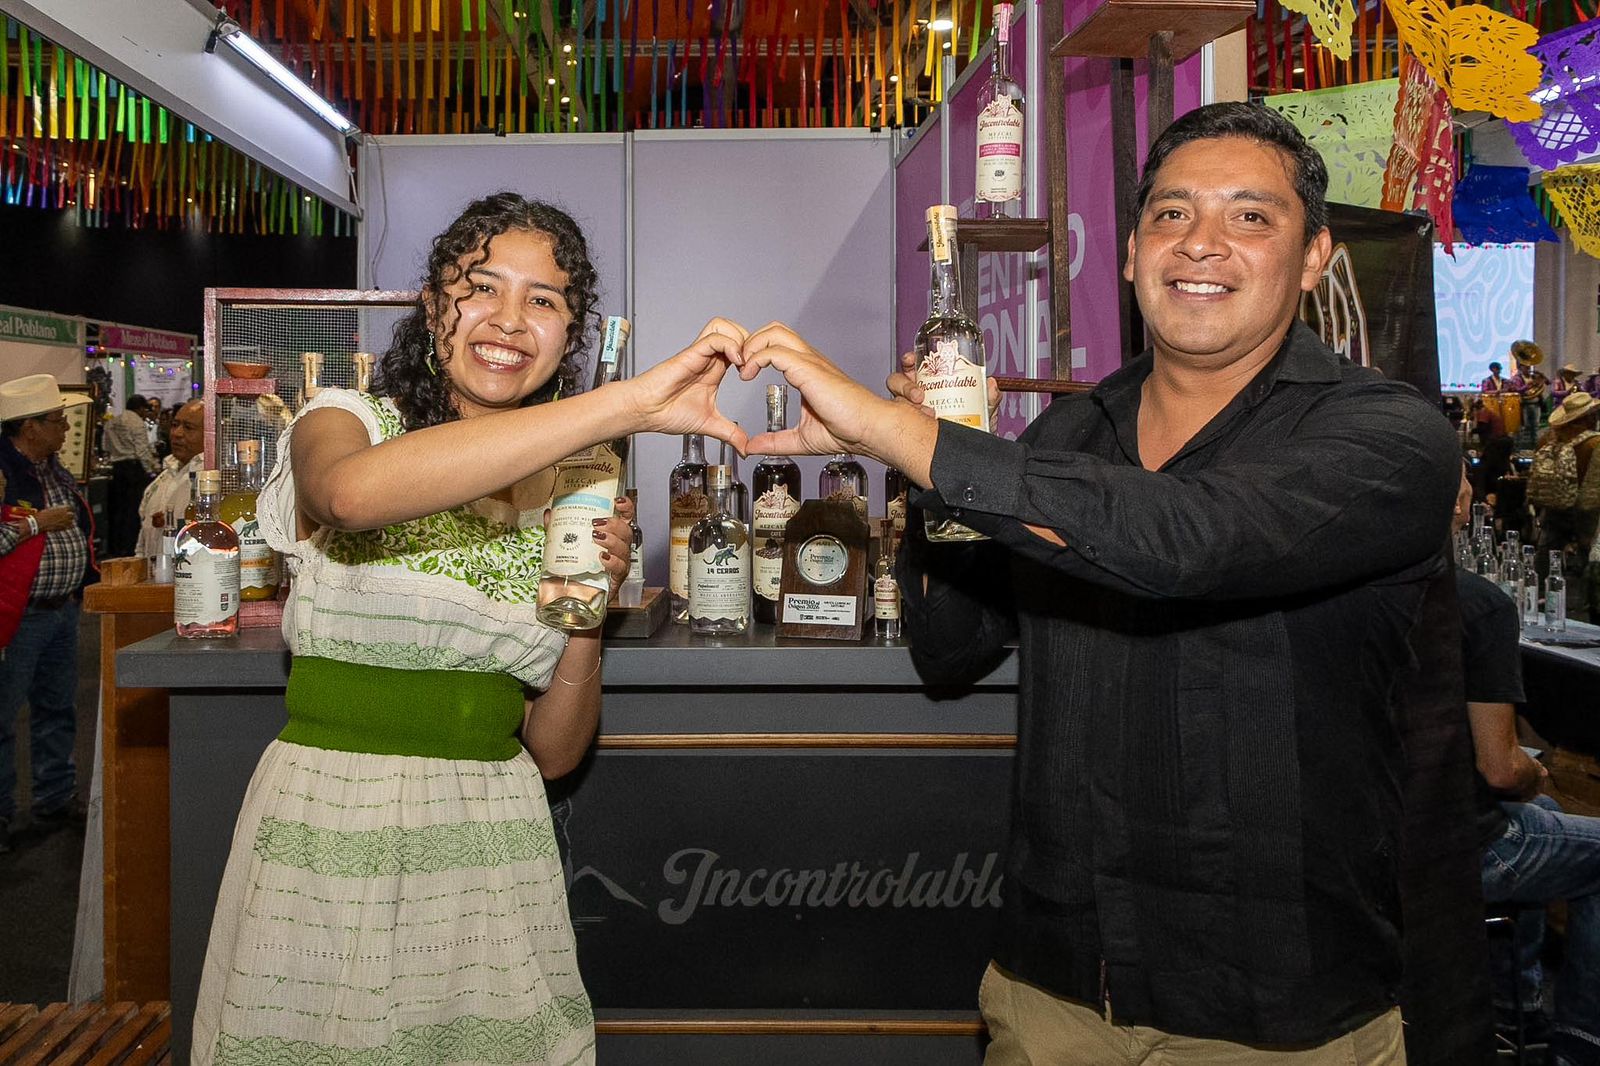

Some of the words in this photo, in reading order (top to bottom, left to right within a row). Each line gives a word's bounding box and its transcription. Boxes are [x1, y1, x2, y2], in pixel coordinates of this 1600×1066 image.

[14, 317, 58, 339] Poblano
[929, 398, 966, 406] MEZCAL
[716, 567, 740, 575] CERROS
[788, 597, 816, 605] Premio
